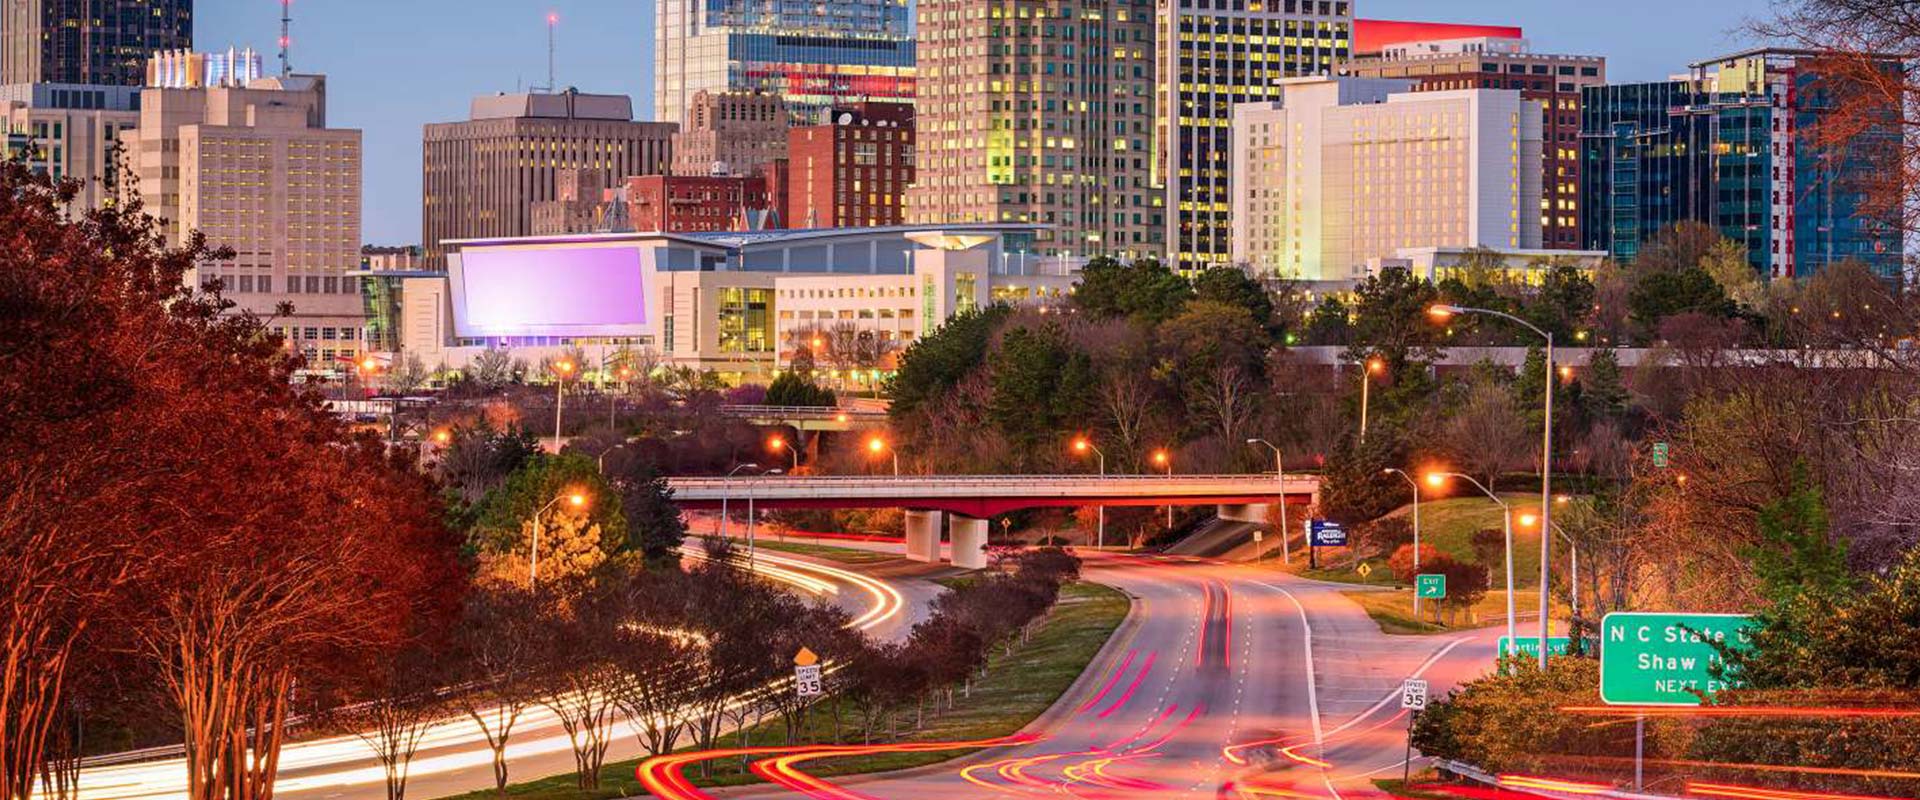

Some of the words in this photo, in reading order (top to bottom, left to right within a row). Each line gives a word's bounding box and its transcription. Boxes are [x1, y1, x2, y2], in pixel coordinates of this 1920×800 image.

[1611, 626, 1625, 642] N
[1638, 626, 1651, 642] C
[1664, 626, 1725, 643] State
[1505, 643, 1540, 652] artin
[1638, 653, 1696, 670] Shaw
[800, 680, 819, 693] 35
[1655, 680, 1698, 693] NEXT
[1708, 681, 1743, 693] EXT
[1404, 693, 1424, 706] 35
